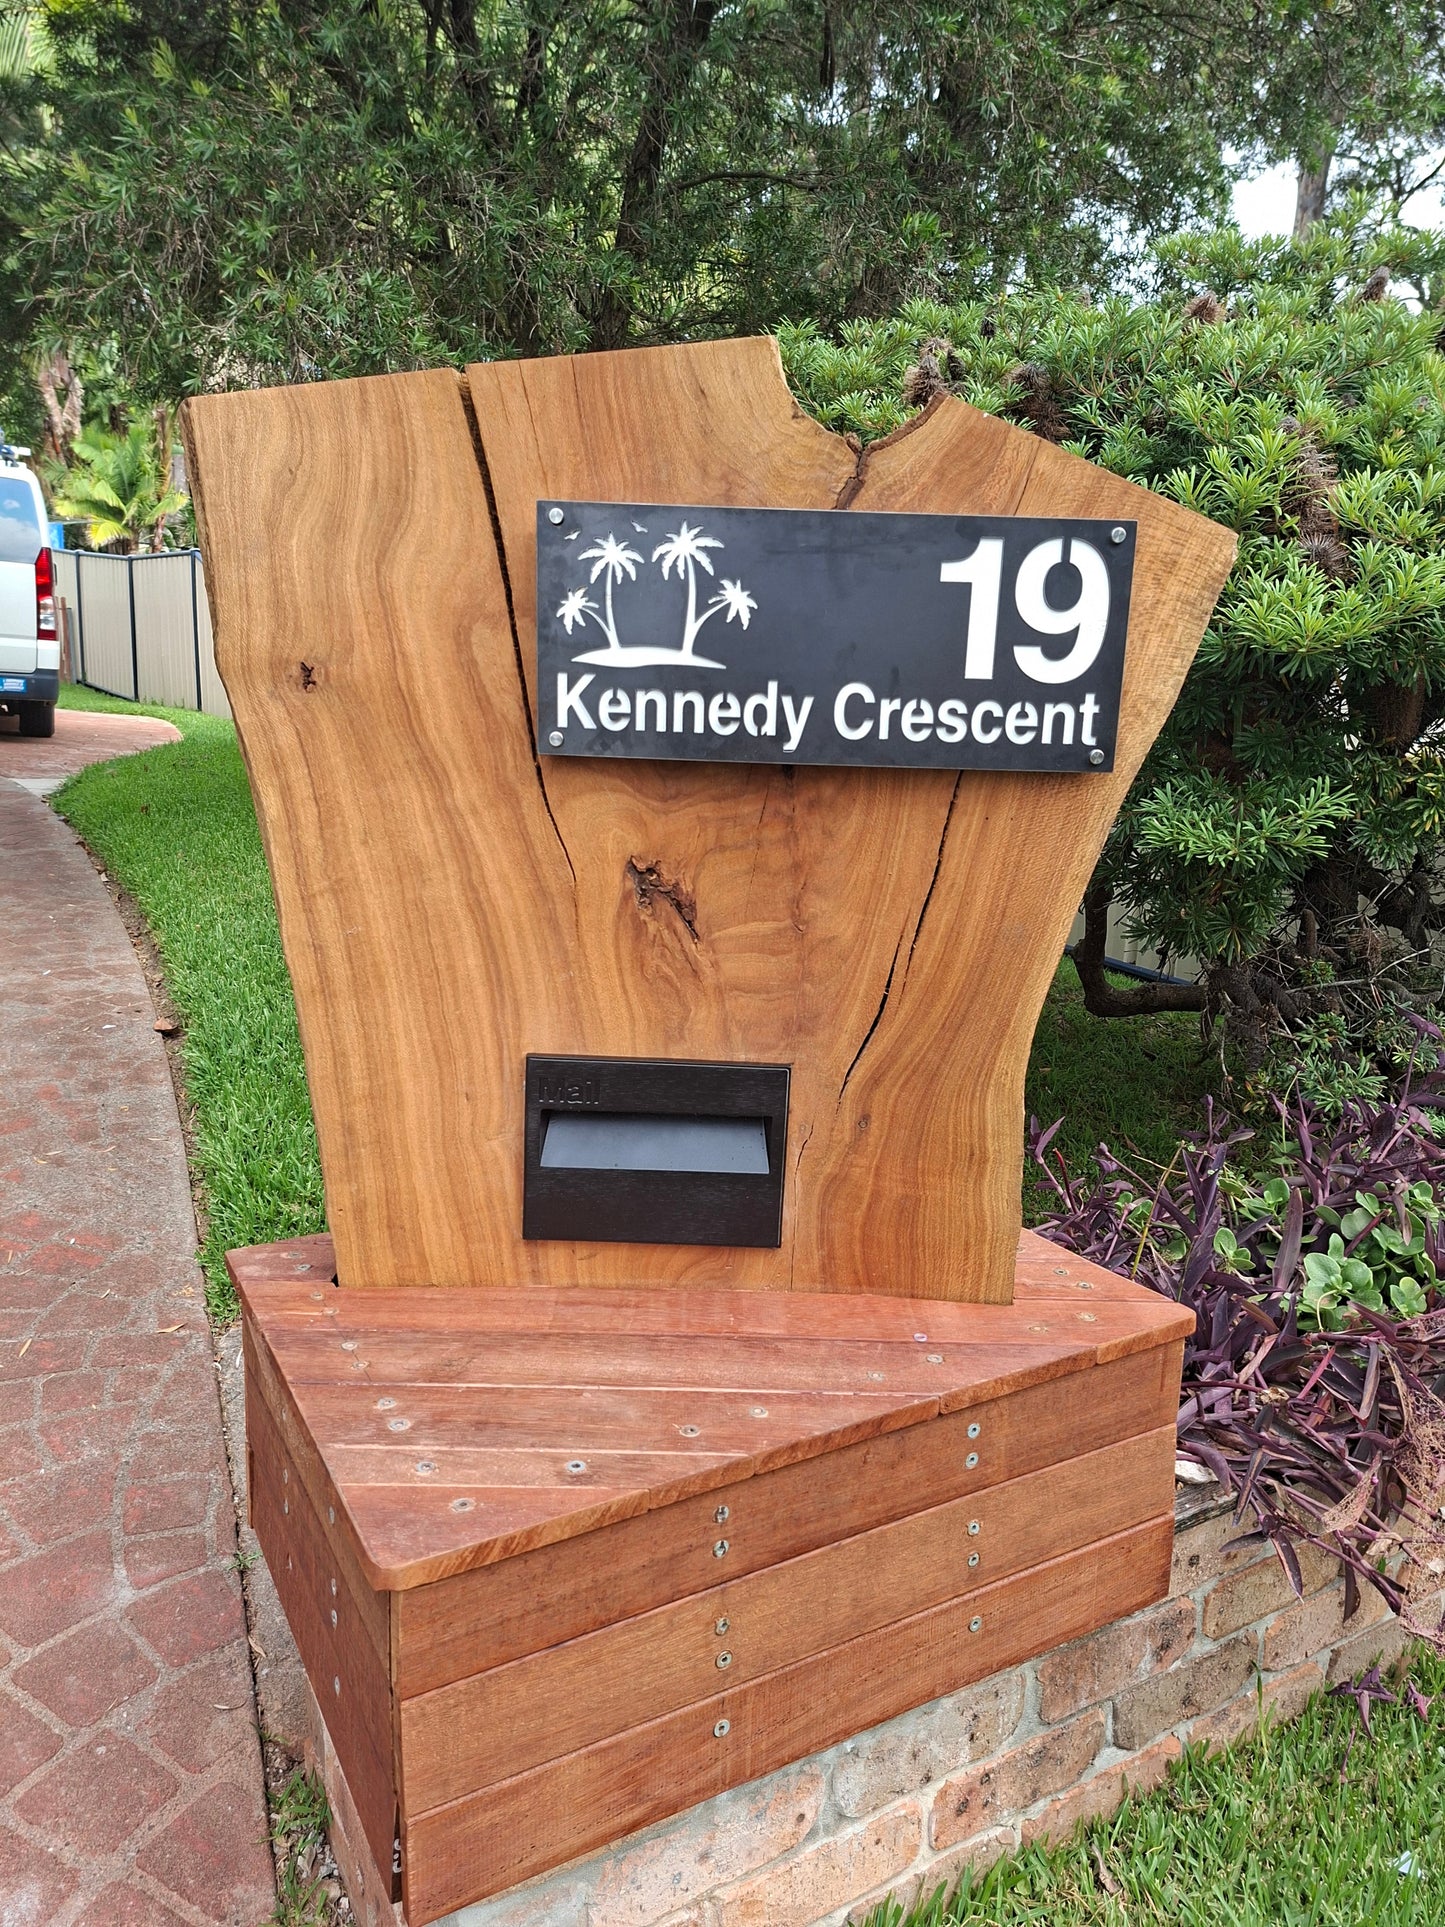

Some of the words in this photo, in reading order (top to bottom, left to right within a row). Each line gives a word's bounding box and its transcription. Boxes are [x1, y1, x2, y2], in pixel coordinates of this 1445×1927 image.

[939, 535, 1111, 685] 19
[555, 671, 815, 752] Kennedy
[833, 682, 1101, 747] Crescent
[538, 1077, 601, 1105] Mail
